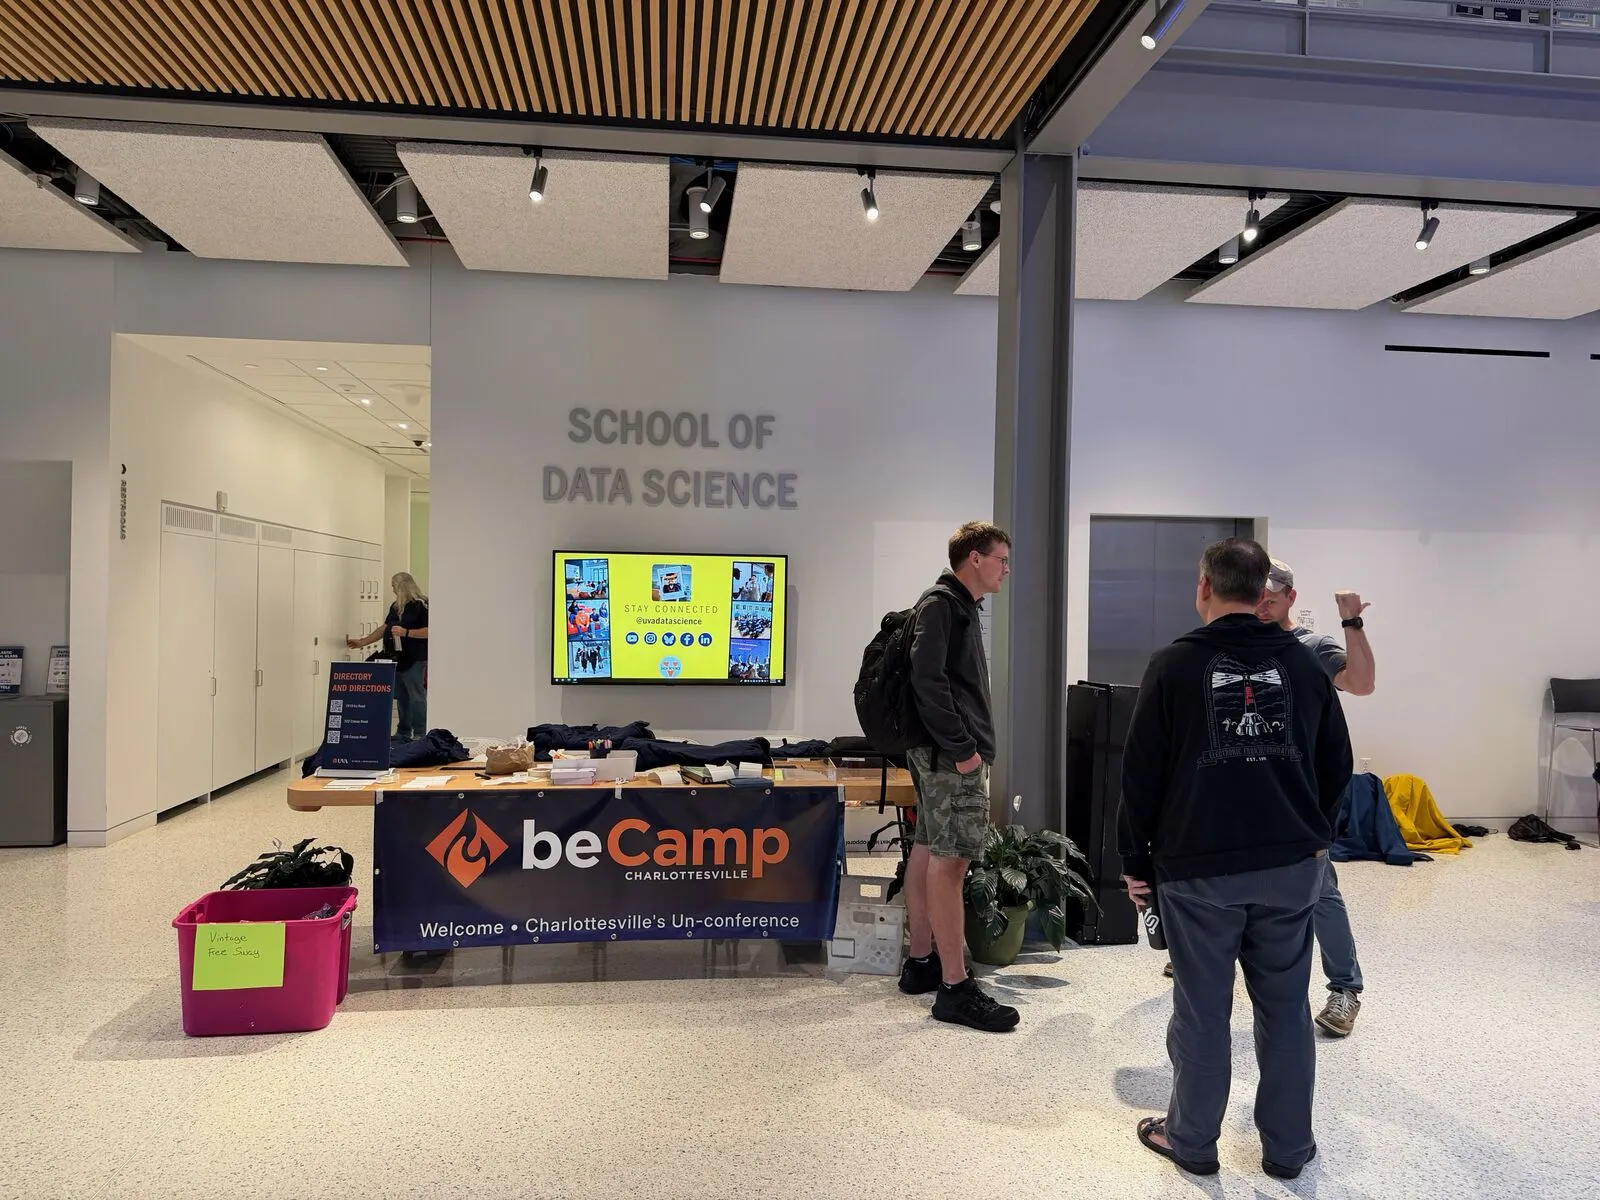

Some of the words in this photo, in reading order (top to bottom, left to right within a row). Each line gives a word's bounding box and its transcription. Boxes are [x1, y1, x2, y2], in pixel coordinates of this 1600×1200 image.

[568, 407, 719, 447] SCHOOL
[728, 413, 776, 449] OF
[542, 465, 633, 504] DATA
[641, 468, 798, 509] SCIENCE
[624, 604, 649, 613] STAY
[655, 605, 718, 614] CONNECTED
[636, 617, 703, 625] @uvadatascience
[333, 672, 373, 681] DIRECTORY
[332, 684, 347, 692] AND
[349, 684, 392, 693] DIRECTIONS
[521, 818, 790, 878] beCamp
[625, 869, 748, 881] CHARLOTTESVILLE
[419, 922, 504, 938] Welcome
[525, 914, 666, 933] Charlottesville's
[672, 912, 800, 929] Un-conference
[210, 931, 248, 945] Vintage
